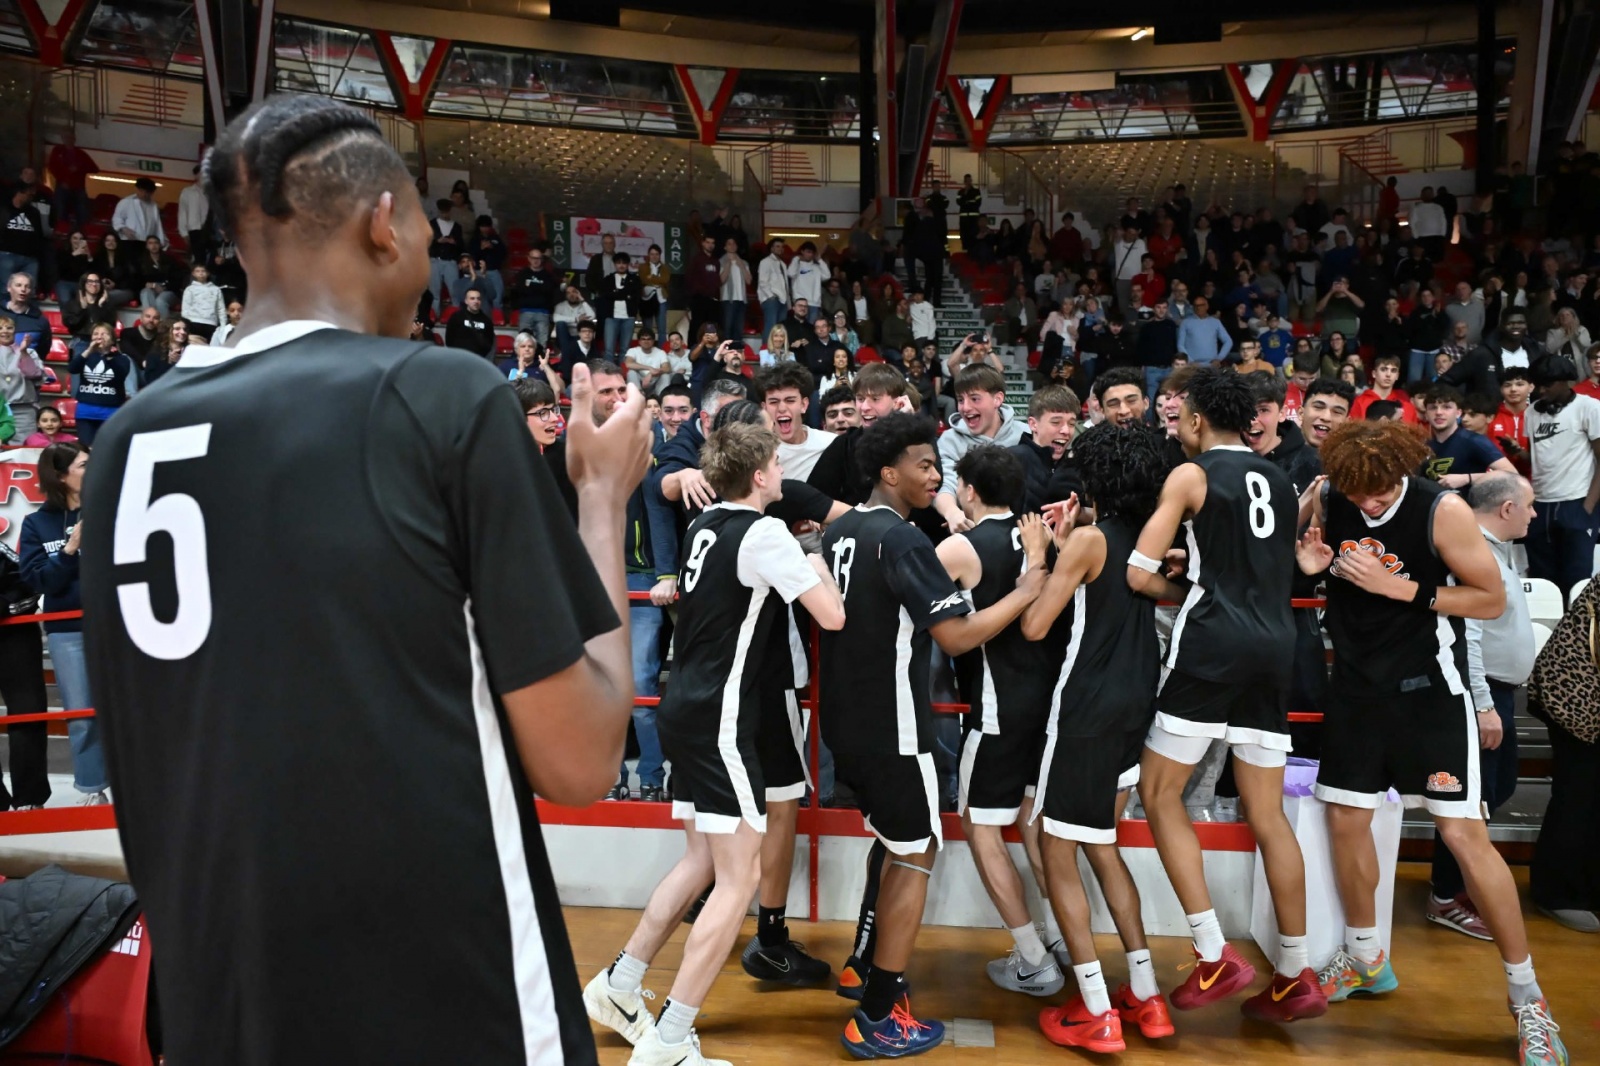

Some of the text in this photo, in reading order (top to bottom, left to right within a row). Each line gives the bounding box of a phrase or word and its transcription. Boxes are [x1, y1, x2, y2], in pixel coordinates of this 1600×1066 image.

[553, 220, 565, 256] BAR
[670, 227, 681, 262] BAR
[79, 384, 116, 395] adidas
[1535, 422, 1561, 435] NIKE
[1245, 471, 1275, 538] 8
[113, 422, 213, 660] 5
[684, 528, 717, 593] 9
[831, 536, 856, 602] 13
